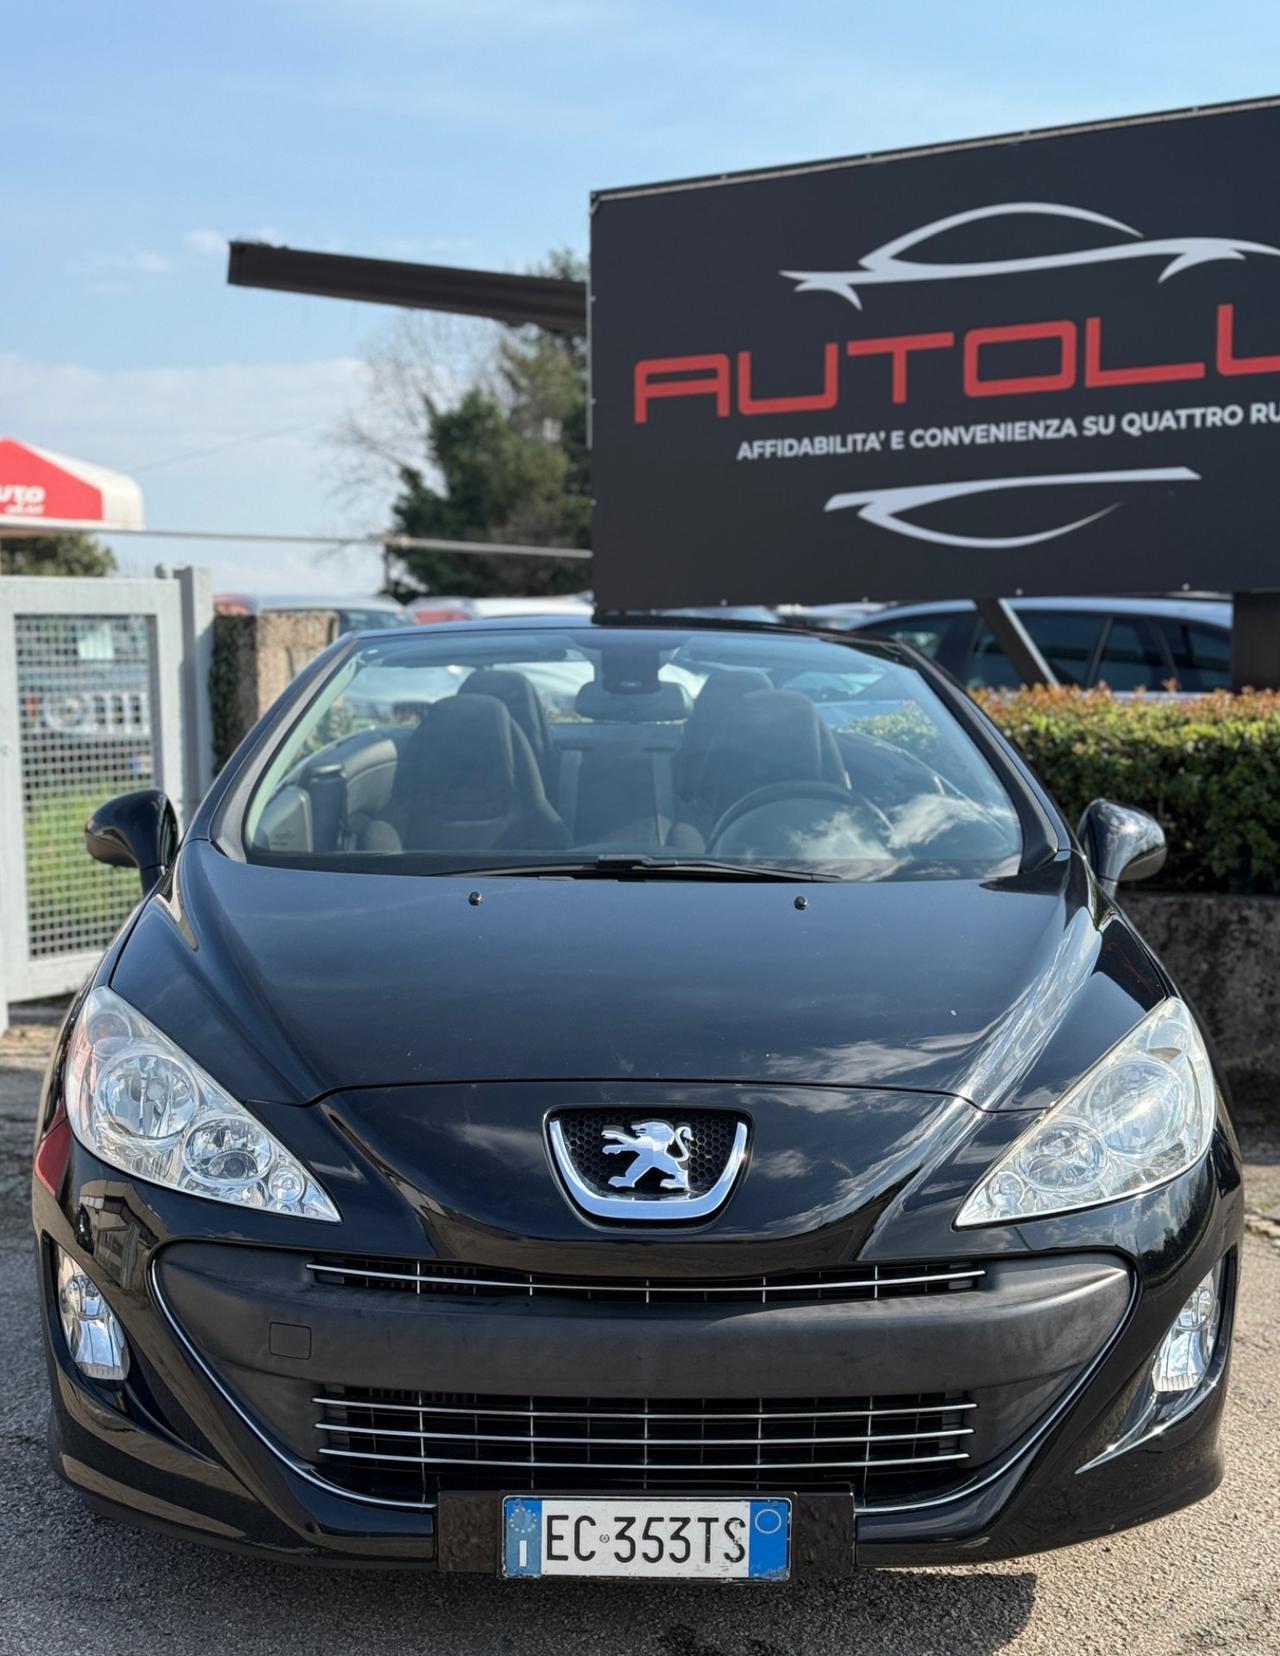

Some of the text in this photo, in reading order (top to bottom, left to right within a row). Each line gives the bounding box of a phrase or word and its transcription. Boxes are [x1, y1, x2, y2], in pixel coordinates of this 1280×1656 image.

[737, 431, 885, 460] AFFIDABILITA'
[890, 430, 905, 450] E
[909, 418, 1078, 449] CONVENIENZA
[1082, 414, 1115, 436] SU
[1121, 404, 1243, 437] QUATTRO
